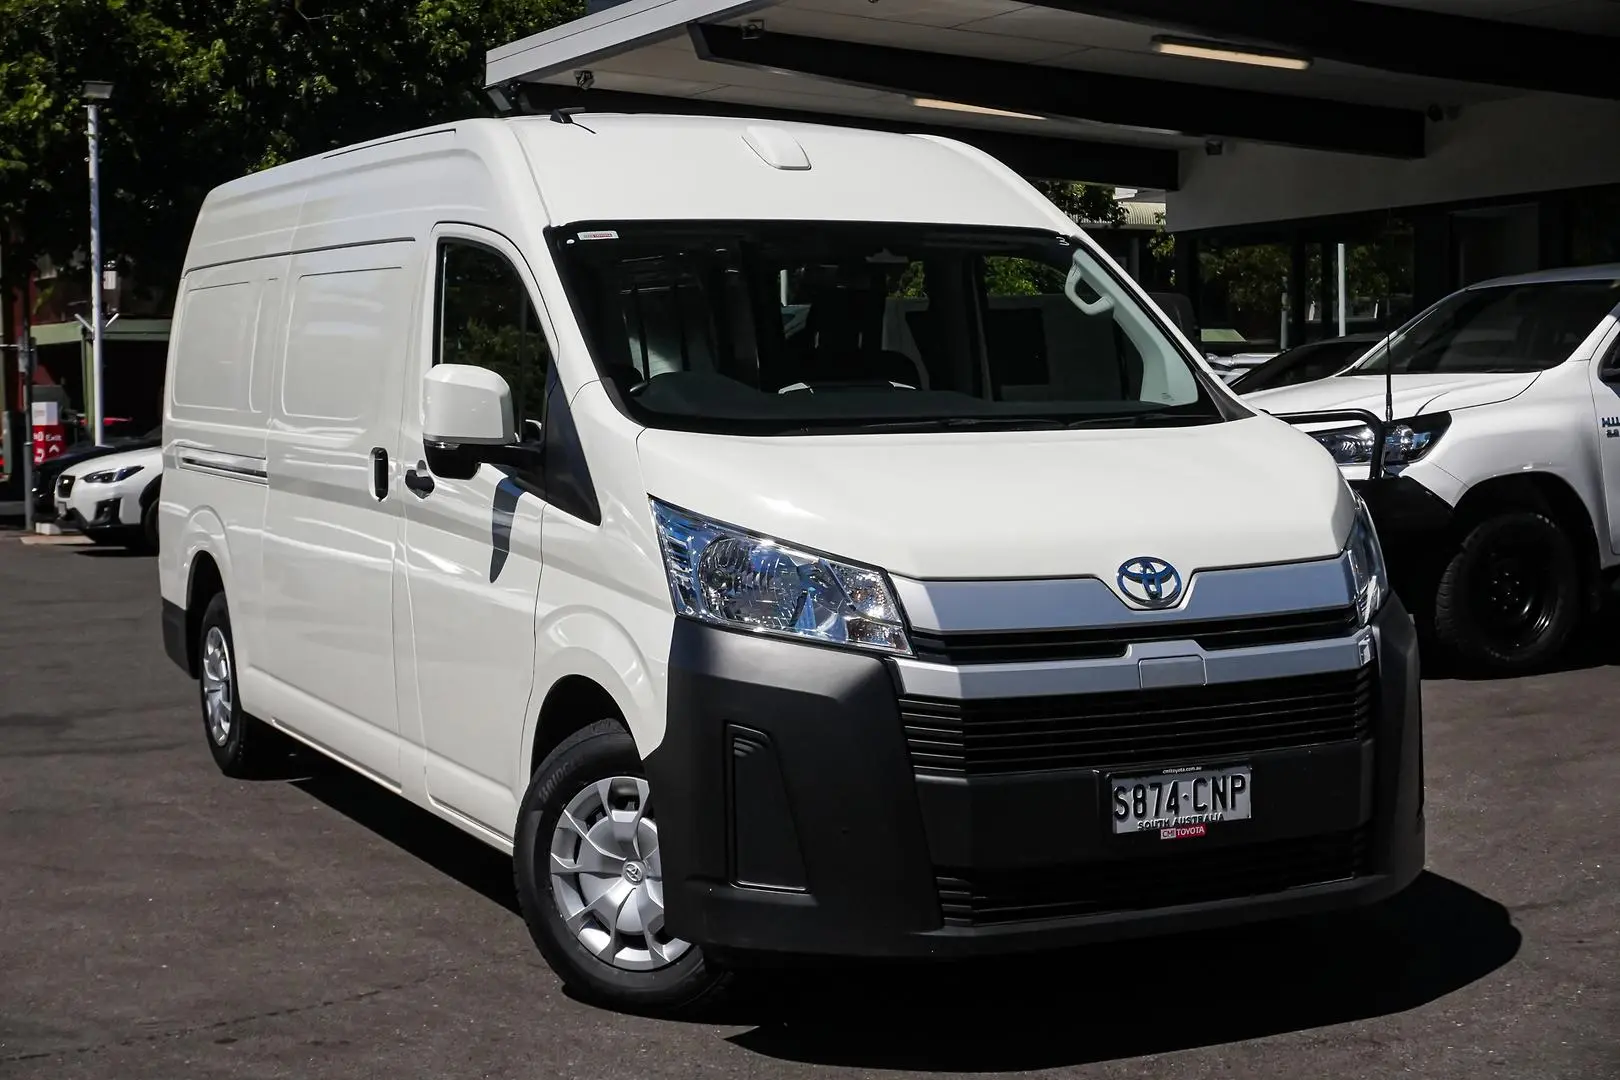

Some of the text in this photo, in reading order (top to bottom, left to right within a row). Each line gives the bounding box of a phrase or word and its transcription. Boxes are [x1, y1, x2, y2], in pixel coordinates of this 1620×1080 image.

[1137, 812, 1225, 830] SOUTH AUSTRALIA
[1176, 826, 1206, 837] TOYOTA
